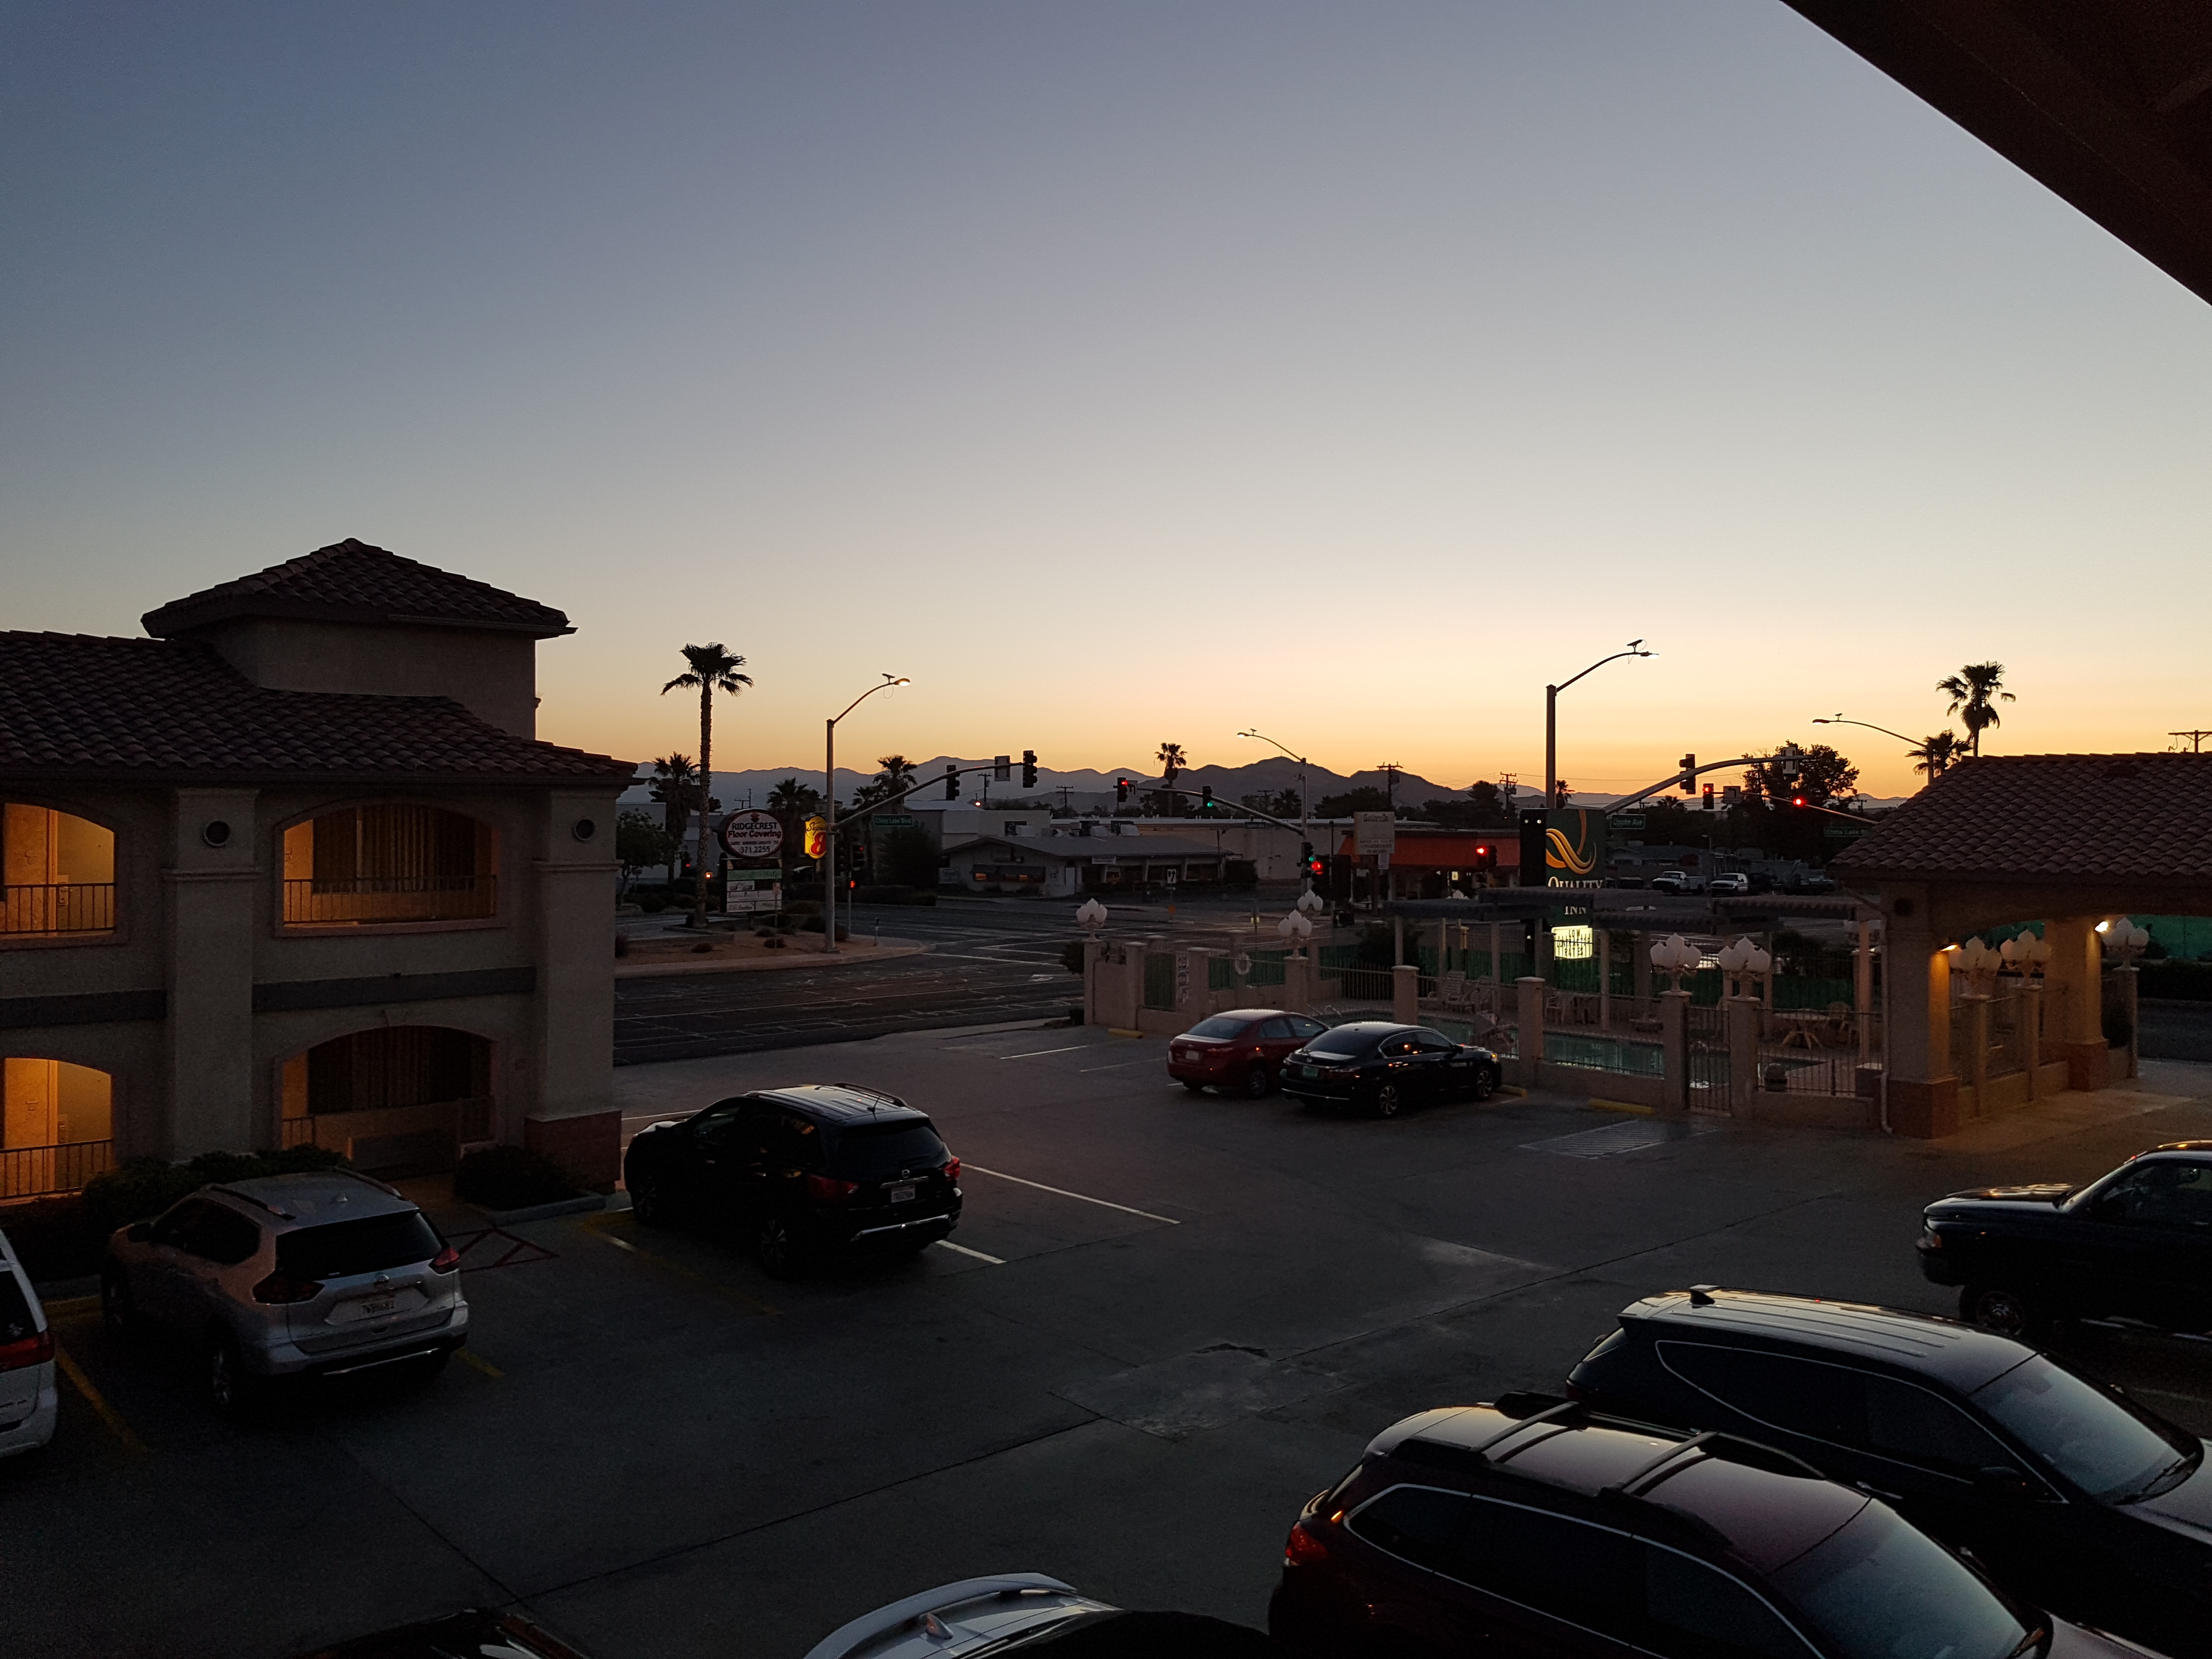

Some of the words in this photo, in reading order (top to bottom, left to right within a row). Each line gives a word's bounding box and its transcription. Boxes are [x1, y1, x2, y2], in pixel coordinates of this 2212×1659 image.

[749, 830, 781, 838] Covering
[811, 832, 827, 855] 8
[1564, 906, 1587, 915] INN
[1568, 929, 1581, 938] LOW
[1564, 947, 1583, 956] RATES
